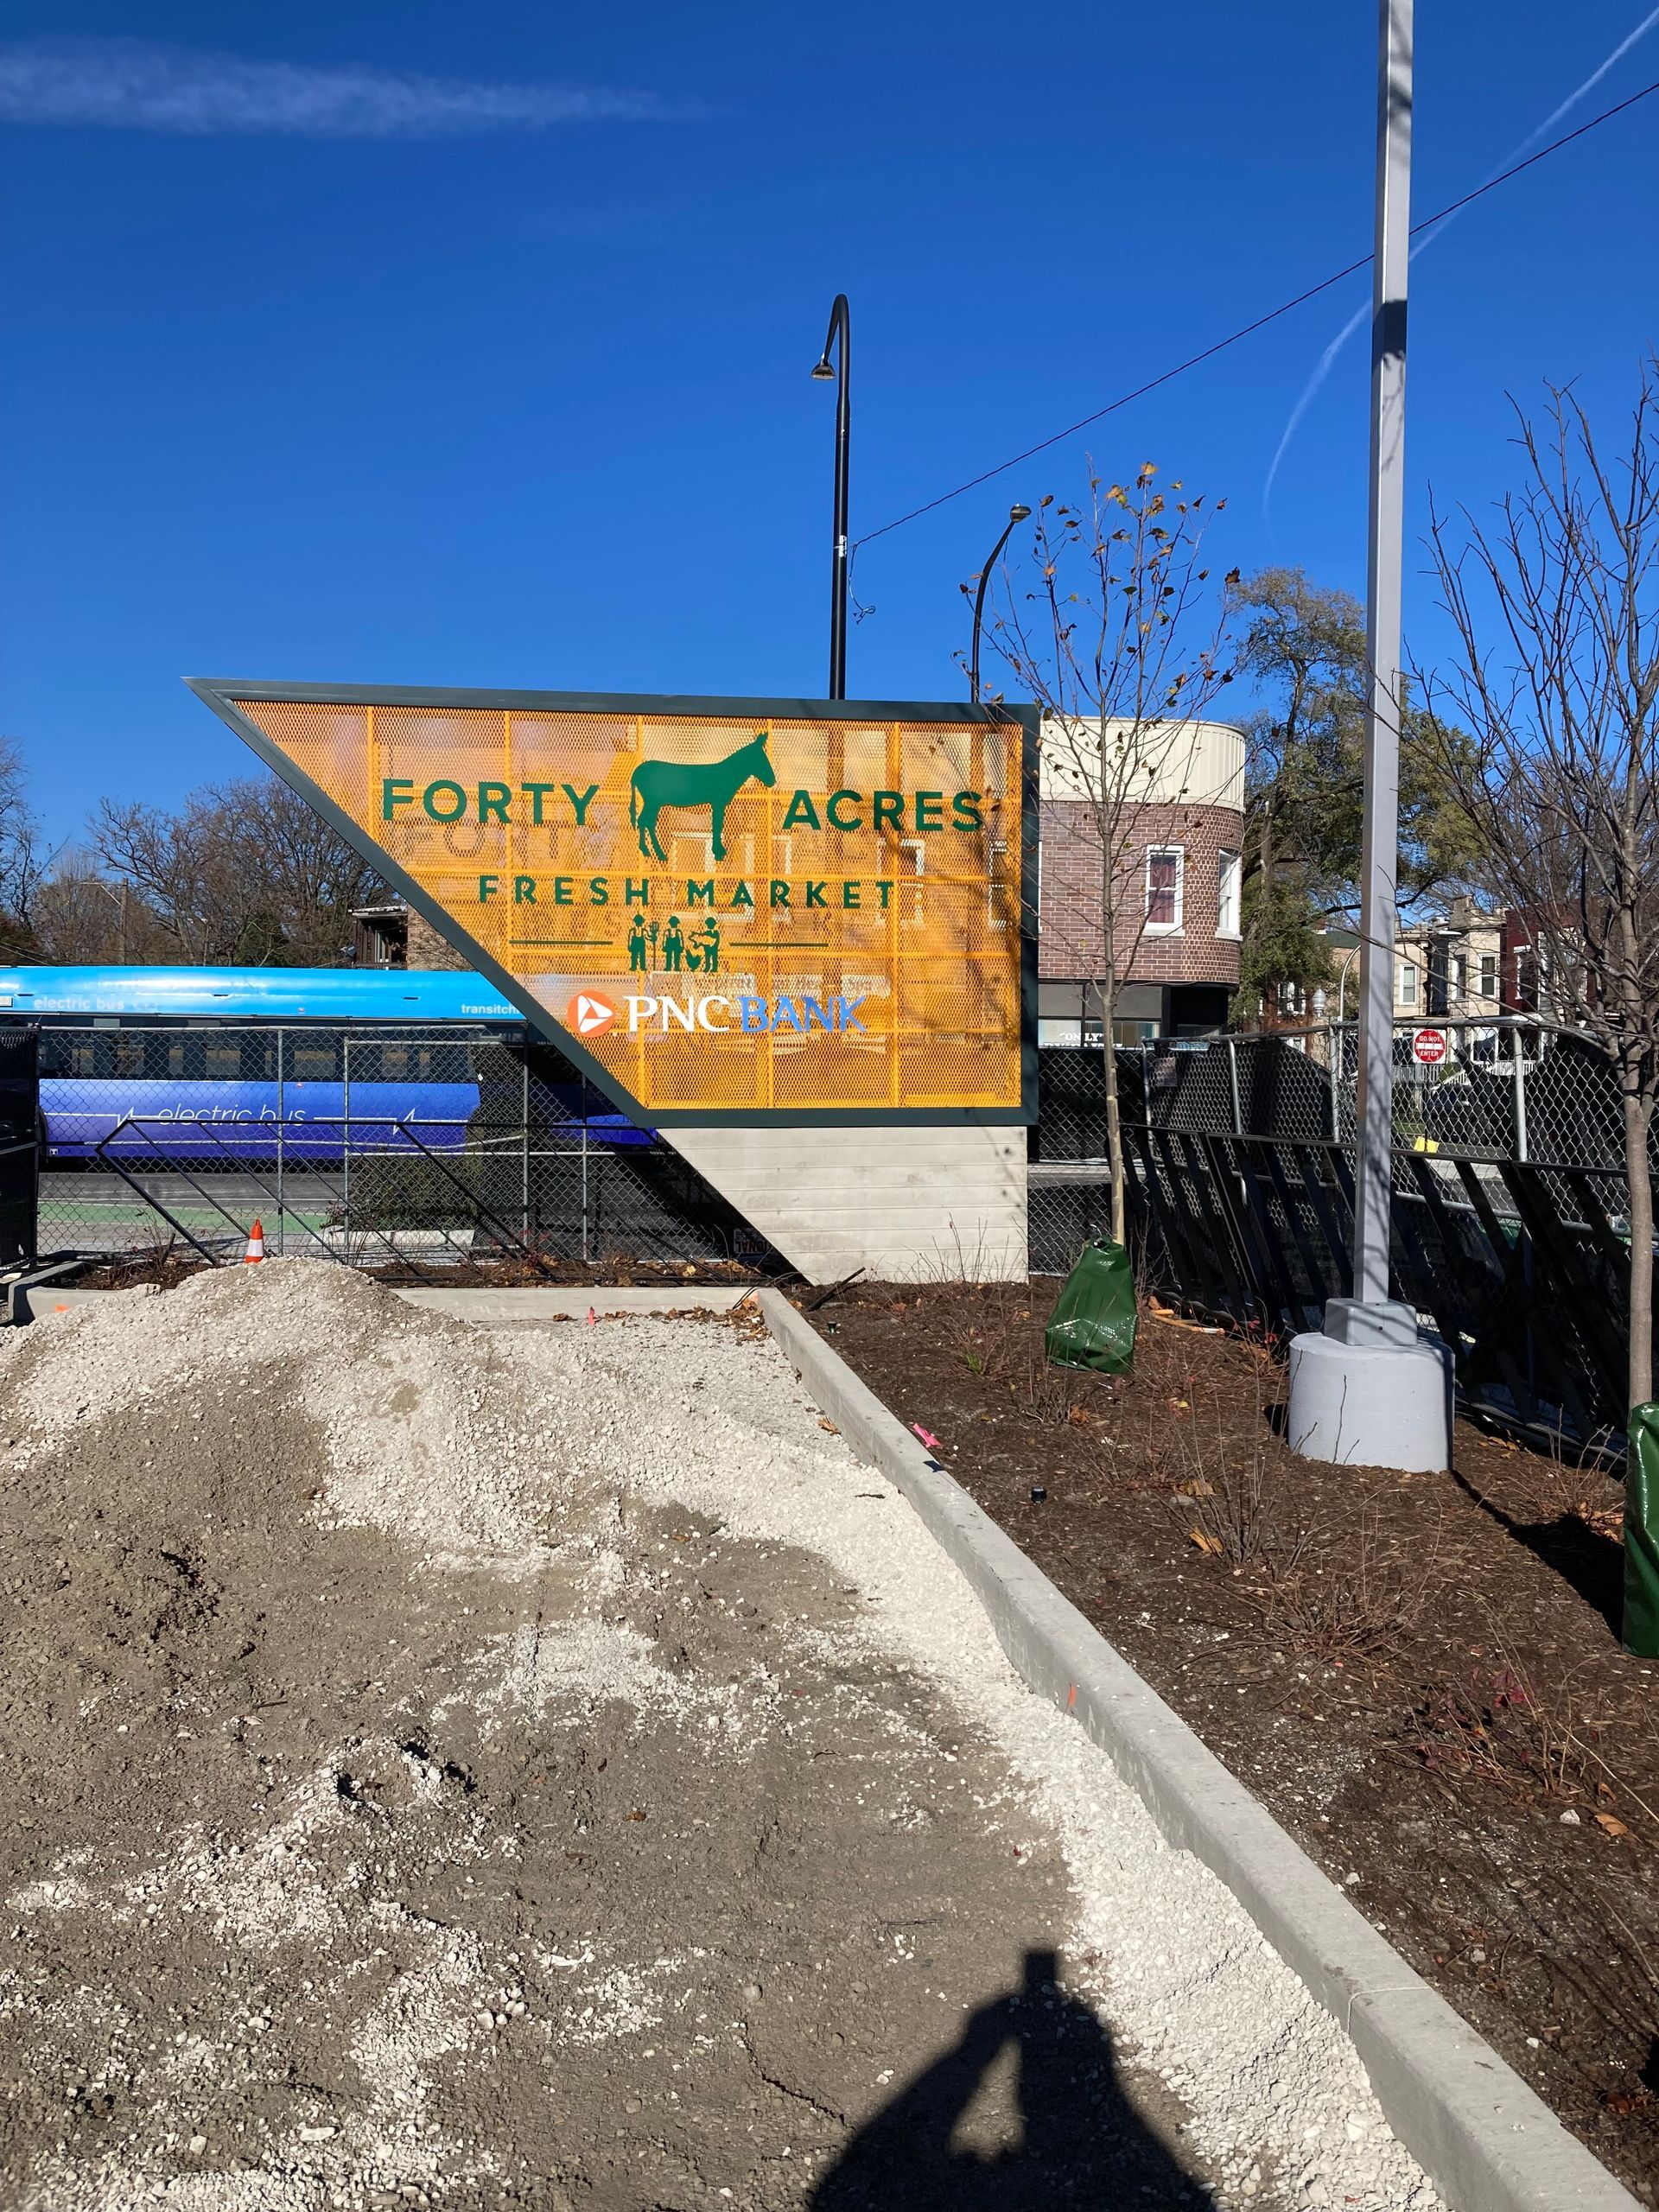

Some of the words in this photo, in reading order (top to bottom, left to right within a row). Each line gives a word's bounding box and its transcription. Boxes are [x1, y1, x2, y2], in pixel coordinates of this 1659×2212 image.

[382, 779, 601, 826] FORTY
[782, 789, 982, 833] ACRES
[479, 875, 649, 907] FRESH
[687, 880, 893, 910] MARKET
[33, 996, 92, 1009] electric
[96, 996, 124, 1009] bus
[622, 995, 731, 1033] PNC
[735, 995, 867, 1033] BANK
[158, 1103, 252, 1126] electric
